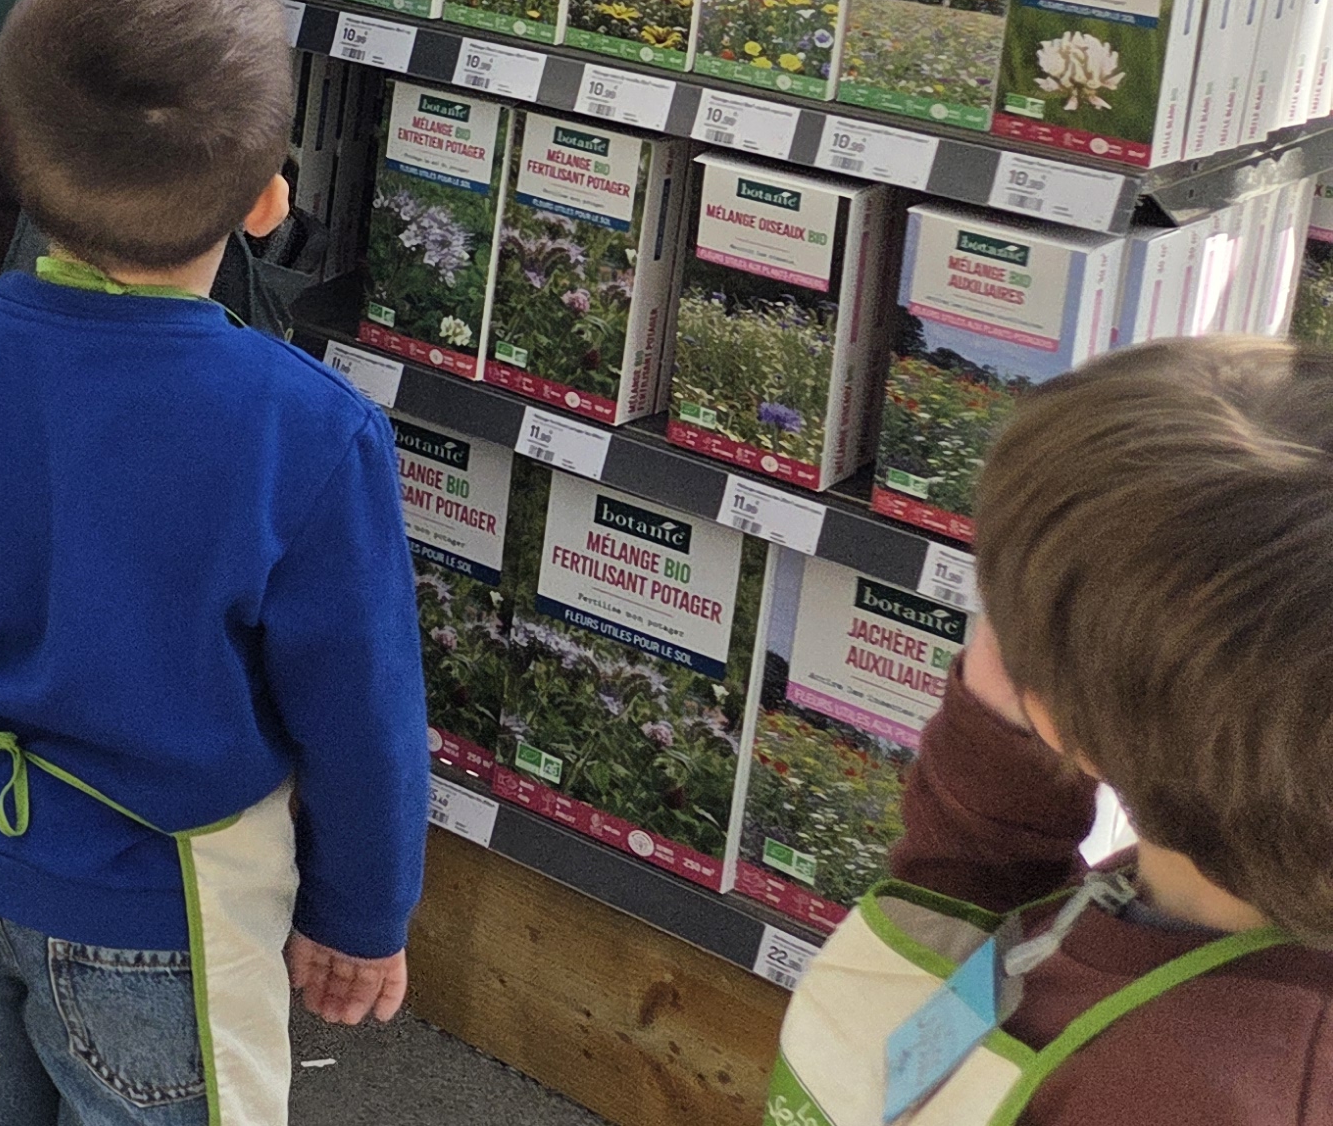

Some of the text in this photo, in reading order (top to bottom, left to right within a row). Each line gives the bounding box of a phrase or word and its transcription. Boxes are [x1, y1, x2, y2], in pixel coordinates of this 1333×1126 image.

[422, 98, 468, 120] botanic
[398, 127, 485, 161] ENTRETIEN POTAGER
[412, 116, 471, 141] MÉLANGE BIO
[556, 130, 608, 153] botanic
[527, 160, 630, 198] FERTILISANT POTAGER
[547, 148, 610, 176] MÉLANGE BIO
[740, 181, 798, 208] botanic
[707, 203, 827, 247] MÉLANGE OISEAUX BIO
[960, 234, 1026, 263] botanic
[948, 254, 1006, 283] MÉLANGE
[948, 273, 1025, 306] AUXILIAIRES
[394, 426, 464, 463] botanic
[446, 475, 469, 498] BIO
[436, 494, 496, 536] POTAGER
[602, 504, 686, 546] botanic
[421, 545, 444, 564] POUR
[446, 554, 455, 567] LE
[456, 558, 472, 574] SOL
[587, 531, 691, 584] MÉLANGE BIO
[552, 545, 722, 624] FERTILISANT POTAGER
[864, 586, 959, 636] botanic
[565, 609, 693, 666] FLEURS UTILES POUR LE SOL
[848, 618, 928, 663] JACHÈRE
[845, 645, 946, 698] AUXILIAIRE
[683, 857, 700, 870] 250
